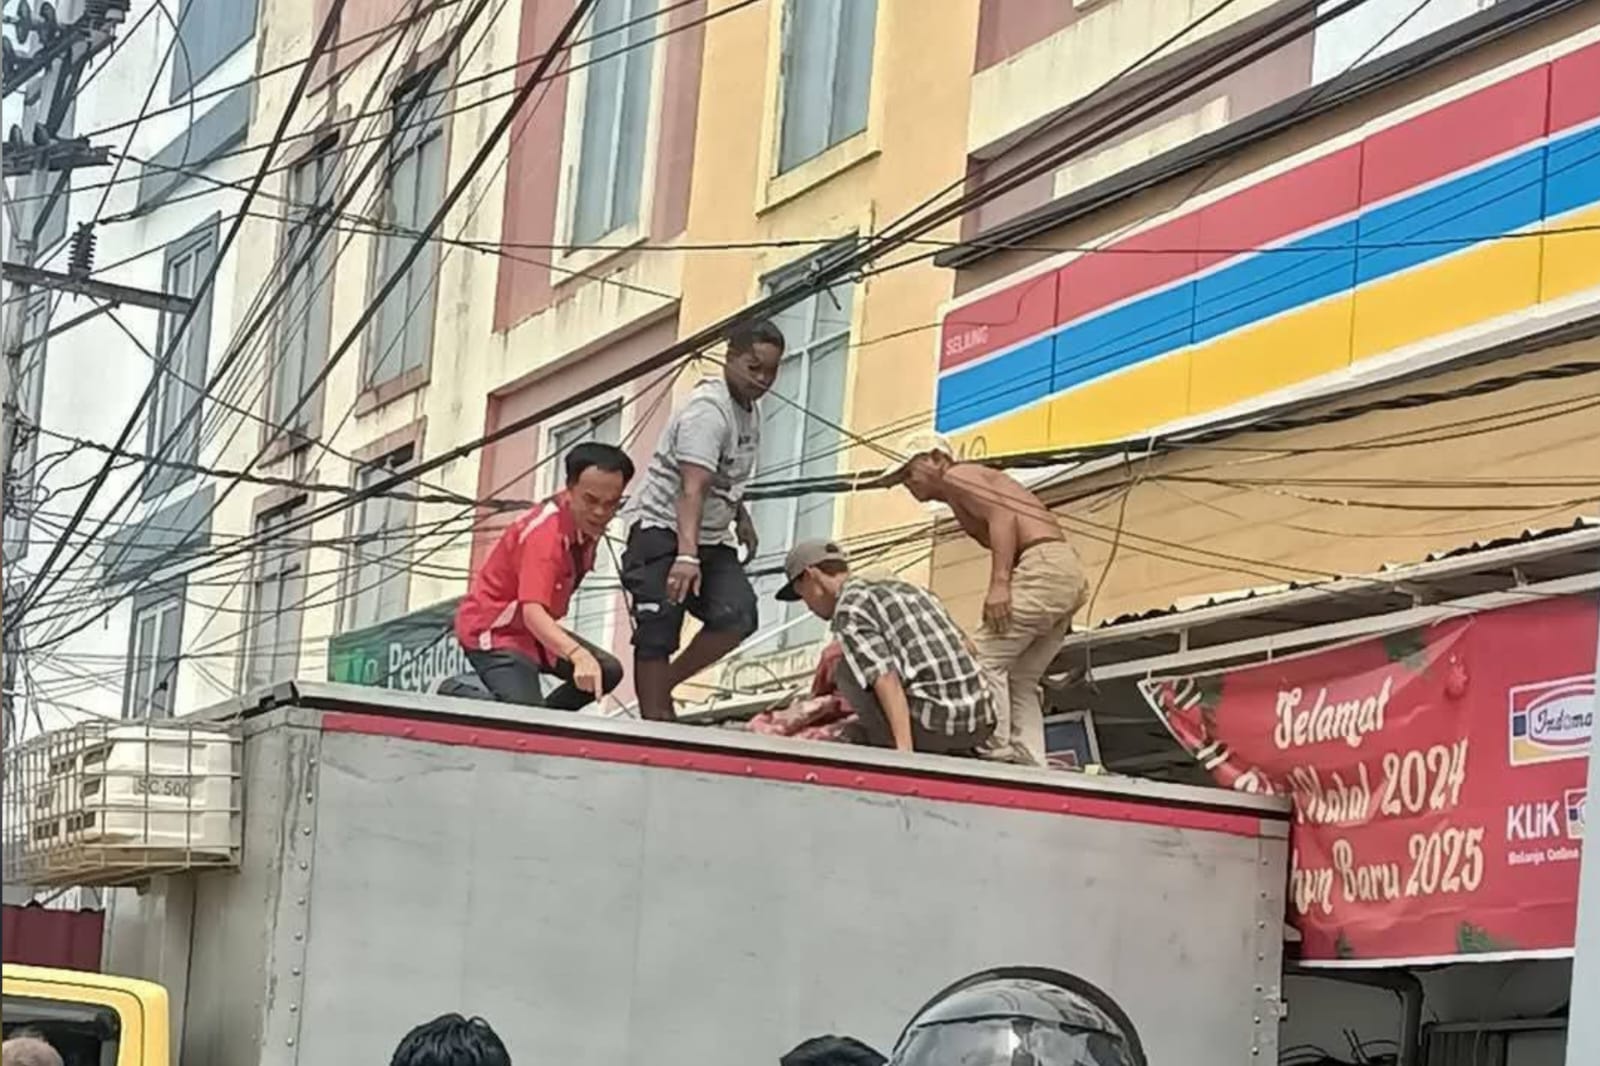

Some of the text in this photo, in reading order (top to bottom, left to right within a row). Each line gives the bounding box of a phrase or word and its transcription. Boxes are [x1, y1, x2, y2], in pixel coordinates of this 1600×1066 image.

[1275, 677, 1392, 749] Selamat
[1534, 709, 1594, 735] Indoma
[1294, 761, 1370, 824] Natal
[1381, 738, 1469, 814] 2024
[1289, 827, 1485, 915] hun Baru 2025
